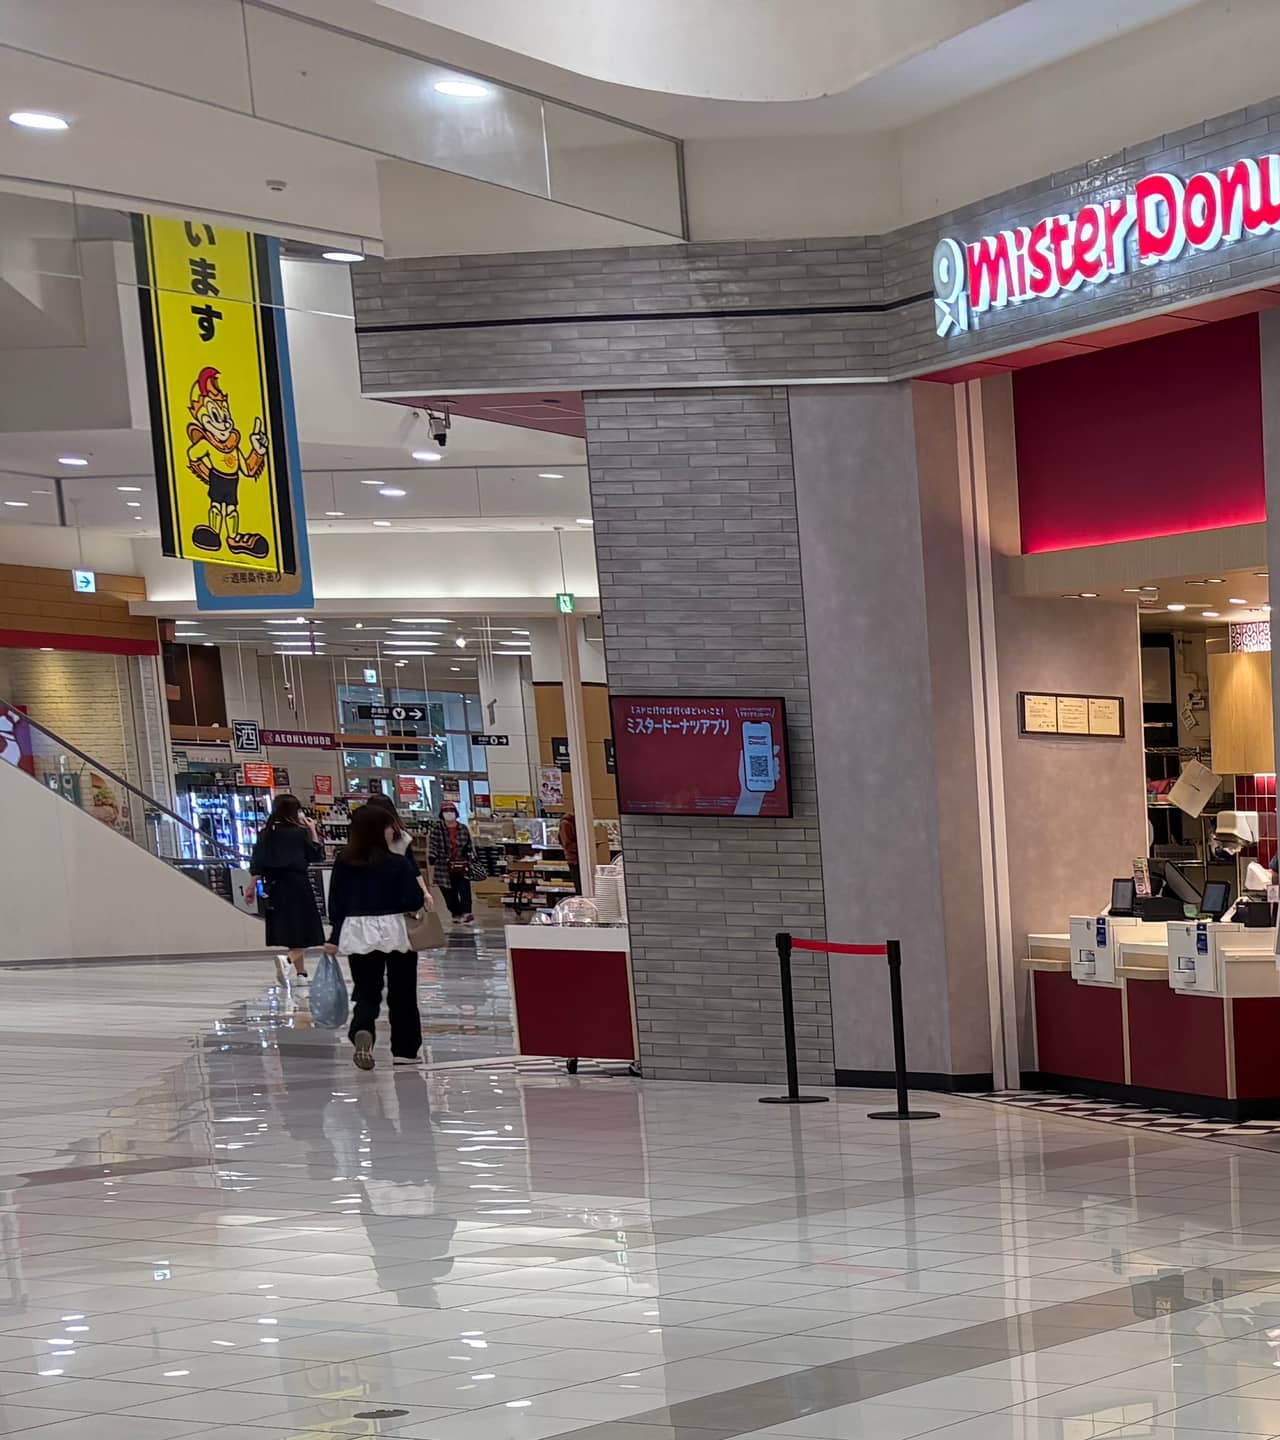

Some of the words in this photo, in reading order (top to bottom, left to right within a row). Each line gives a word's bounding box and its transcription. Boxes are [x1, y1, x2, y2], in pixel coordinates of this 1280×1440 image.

[236, 724, 257, 749] 酒
[627, 718, 730, 735] ミスタードーナツアプリ
